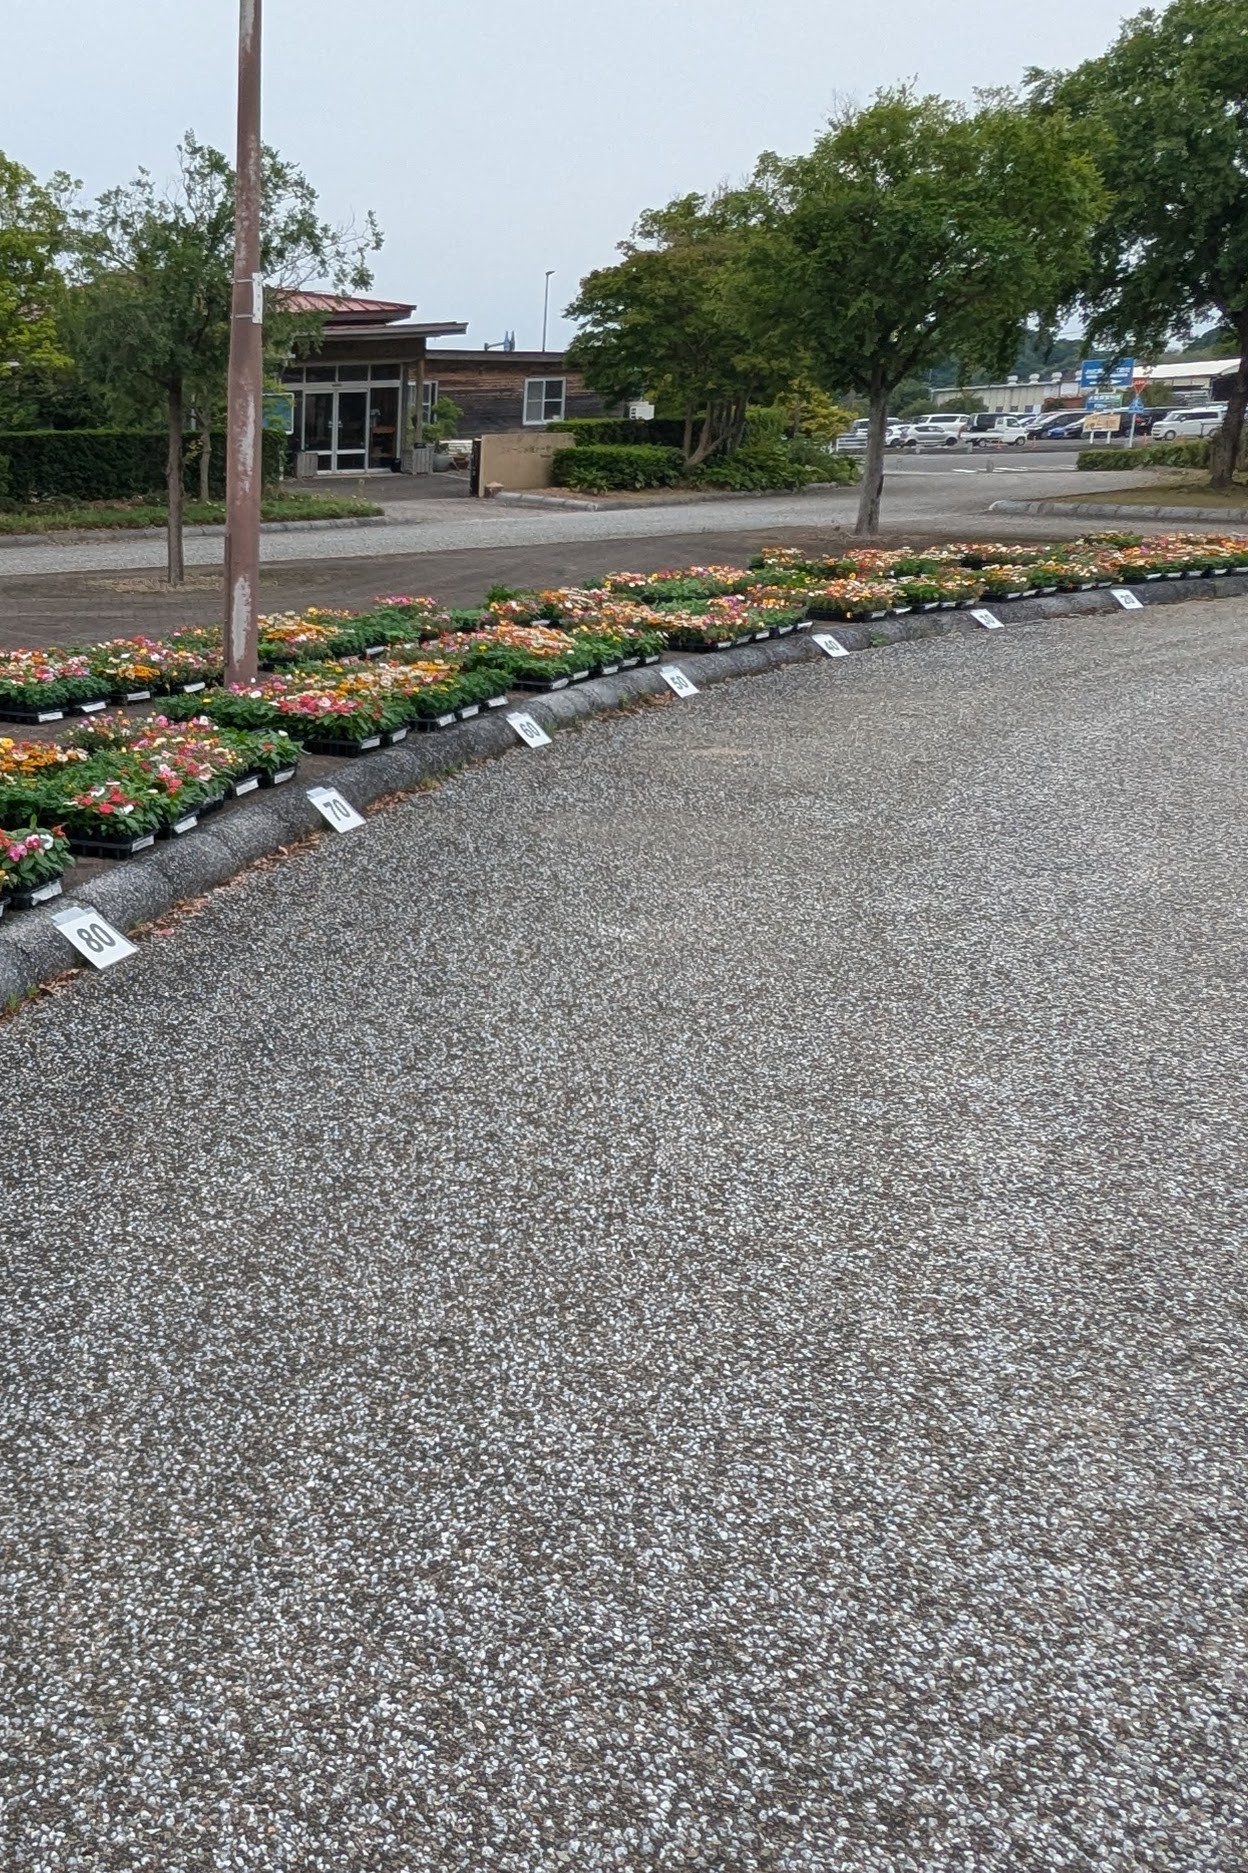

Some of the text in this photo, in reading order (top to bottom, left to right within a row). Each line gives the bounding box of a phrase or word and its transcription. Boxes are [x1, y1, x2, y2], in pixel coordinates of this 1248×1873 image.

[823, 640, 840, 652] 40
[670, 676, 689, 690] 50
[519, 722, 541, 738] 60
[322, 798, 351, 822] 70
[76, 922, 117, 953] 80
